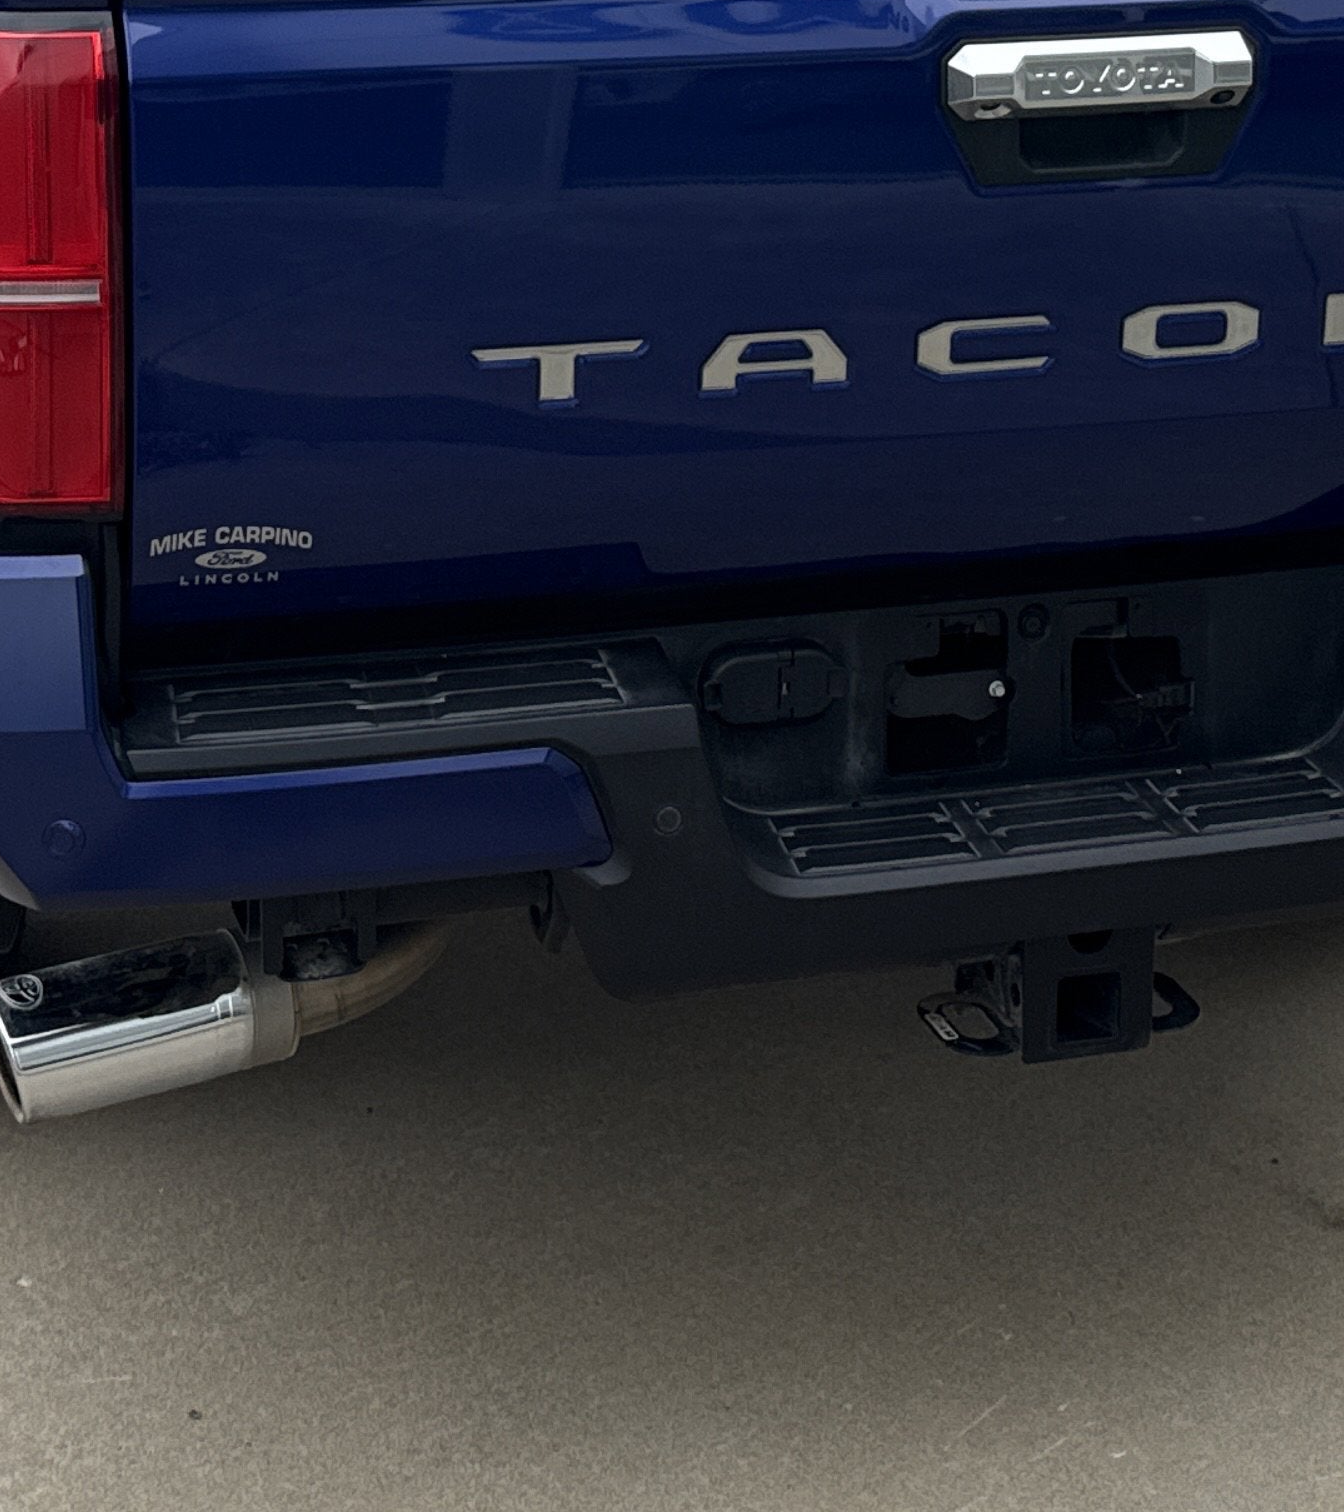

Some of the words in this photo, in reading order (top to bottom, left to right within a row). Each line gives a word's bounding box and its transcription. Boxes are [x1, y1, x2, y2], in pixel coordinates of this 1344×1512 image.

[1033, 62, 1186, 96] TOYOTA
[149, 528, 207, 557] MIKE
[214, 526, 313, 550] CARPINO
[206, 550, 254, 567] Ford
[178, 571, 280, 586] LINCOLN
